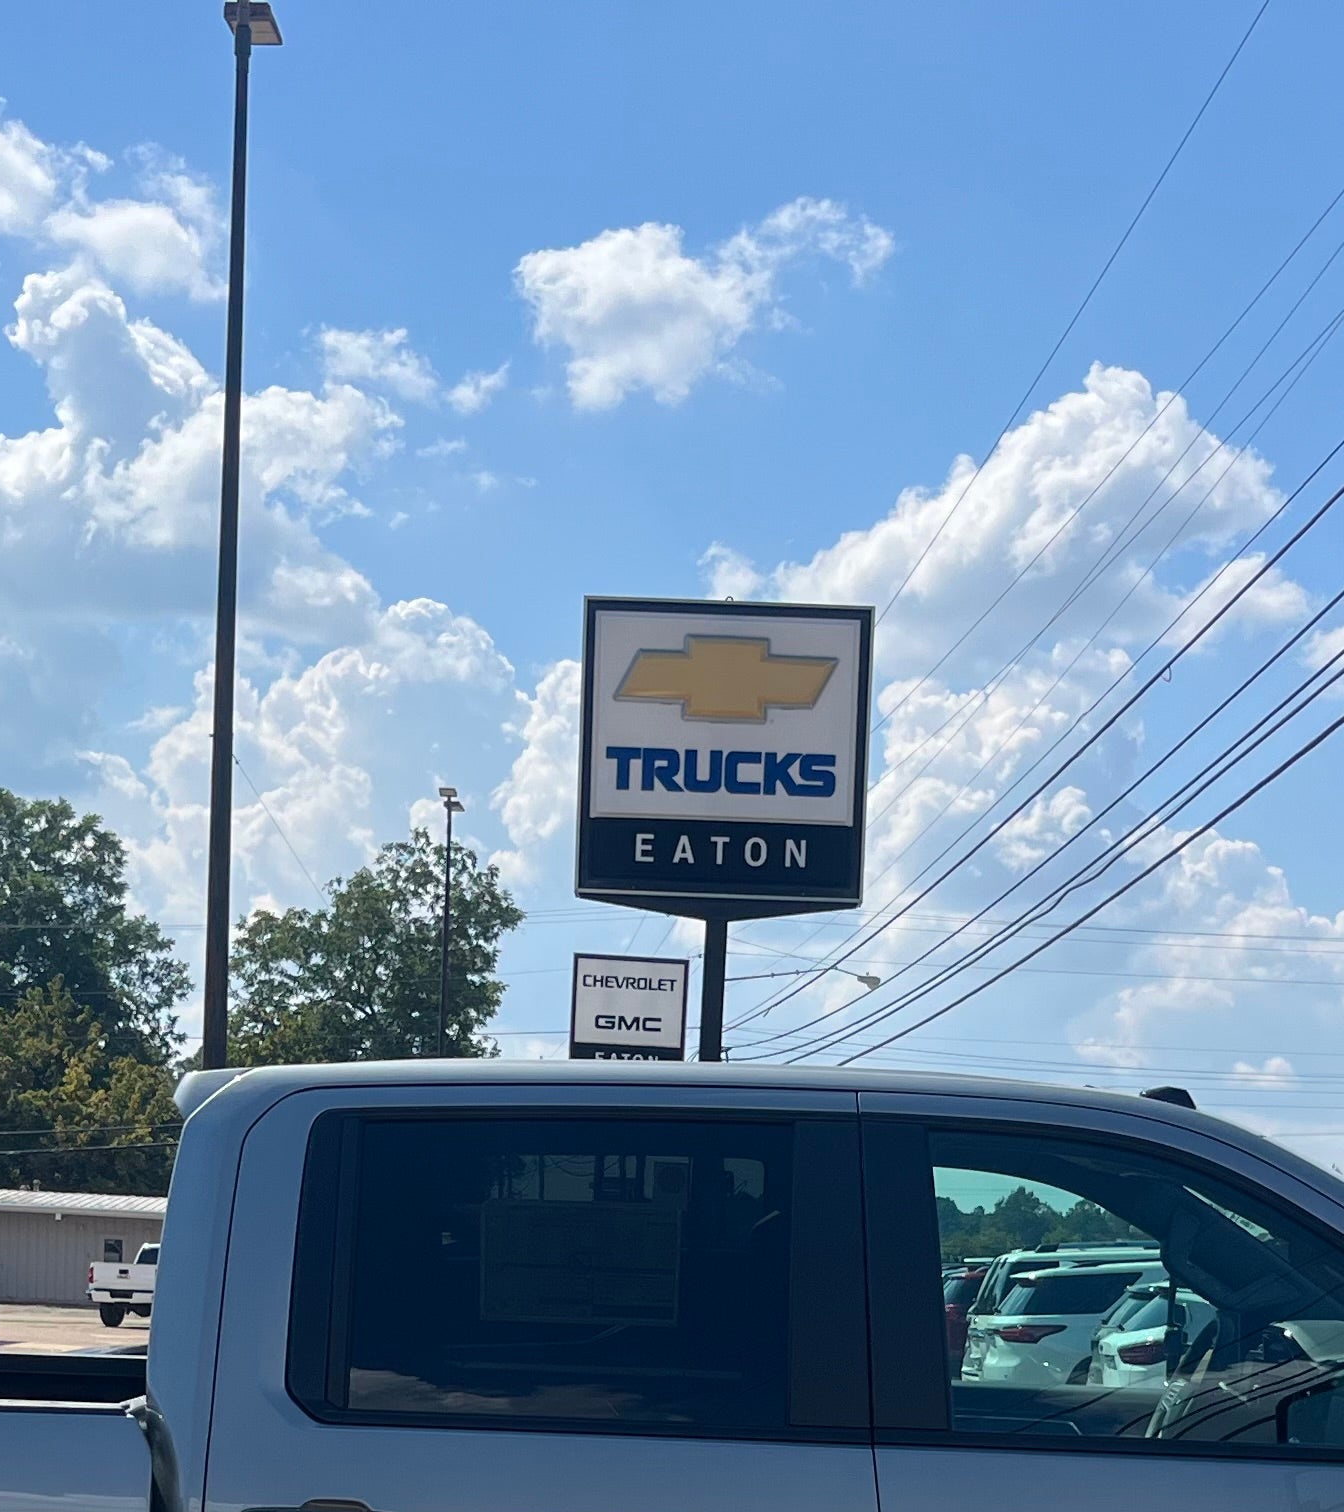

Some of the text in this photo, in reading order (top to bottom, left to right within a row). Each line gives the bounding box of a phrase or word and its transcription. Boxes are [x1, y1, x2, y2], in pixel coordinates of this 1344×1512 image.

[606, 746, 836, 798] TRUCKS
[634, 833, 808, 869] EATON
[582, 974, 677, 992] CHEVROLET
[594, 1014, 662, 1032] GMC
